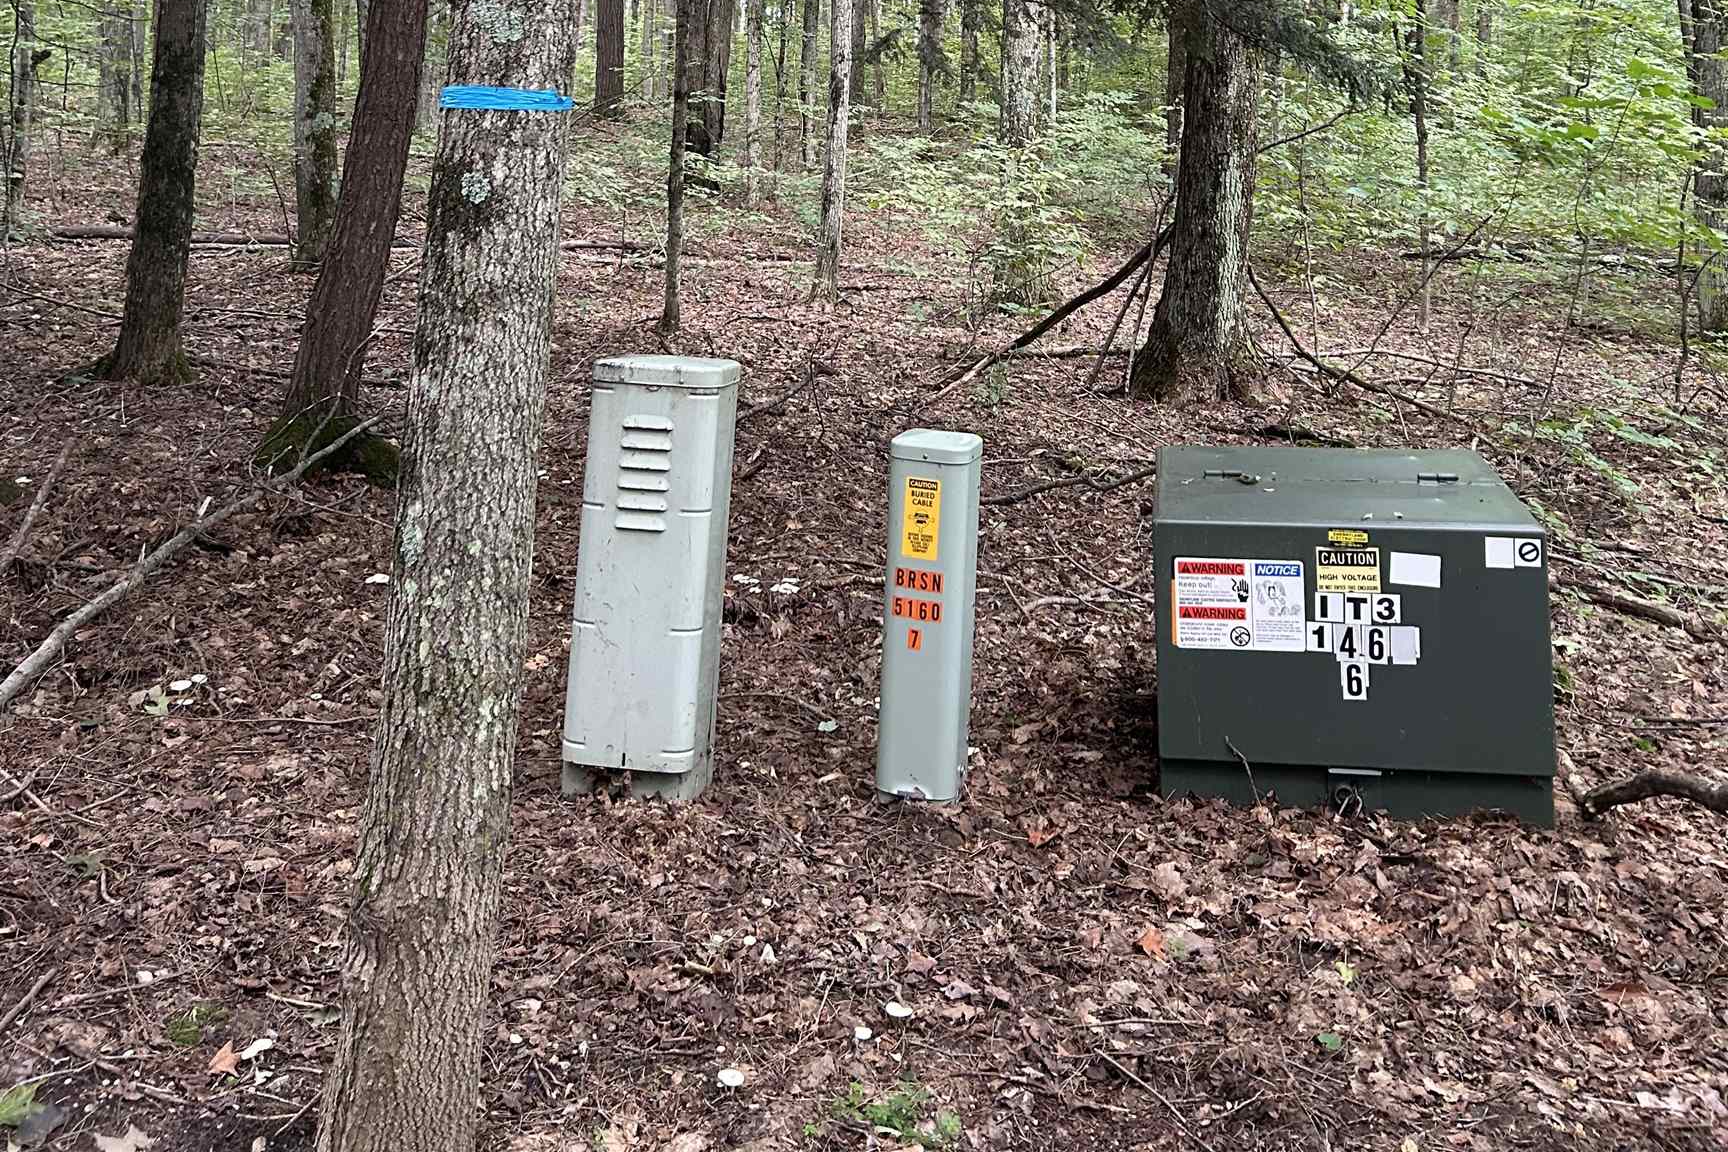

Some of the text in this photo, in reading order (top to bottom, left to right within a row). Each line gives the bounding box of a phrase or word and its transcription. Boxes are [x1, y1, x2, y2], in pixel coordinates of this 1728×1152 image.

[911, 479, 937, 490] CAUTION
[911, 490, 935, 500] BURIED
[912, 498, 933, 508] CABLE
[1321, 552, 1375, 565] CAUTION
[1191, 562, 1245, 575] WARNING
[1257, 565, 1299, 576] NOTICE
[896, 568, 942, 592] BRSN
[1342, 574, 1378, 582] VOLTAGE
[894, 597, 941, 621] 5160
[1192, 608, 1246, 620] WARNING
[911, 630, 919, 647] 7
[1346, 664, 1363, 697] 6
